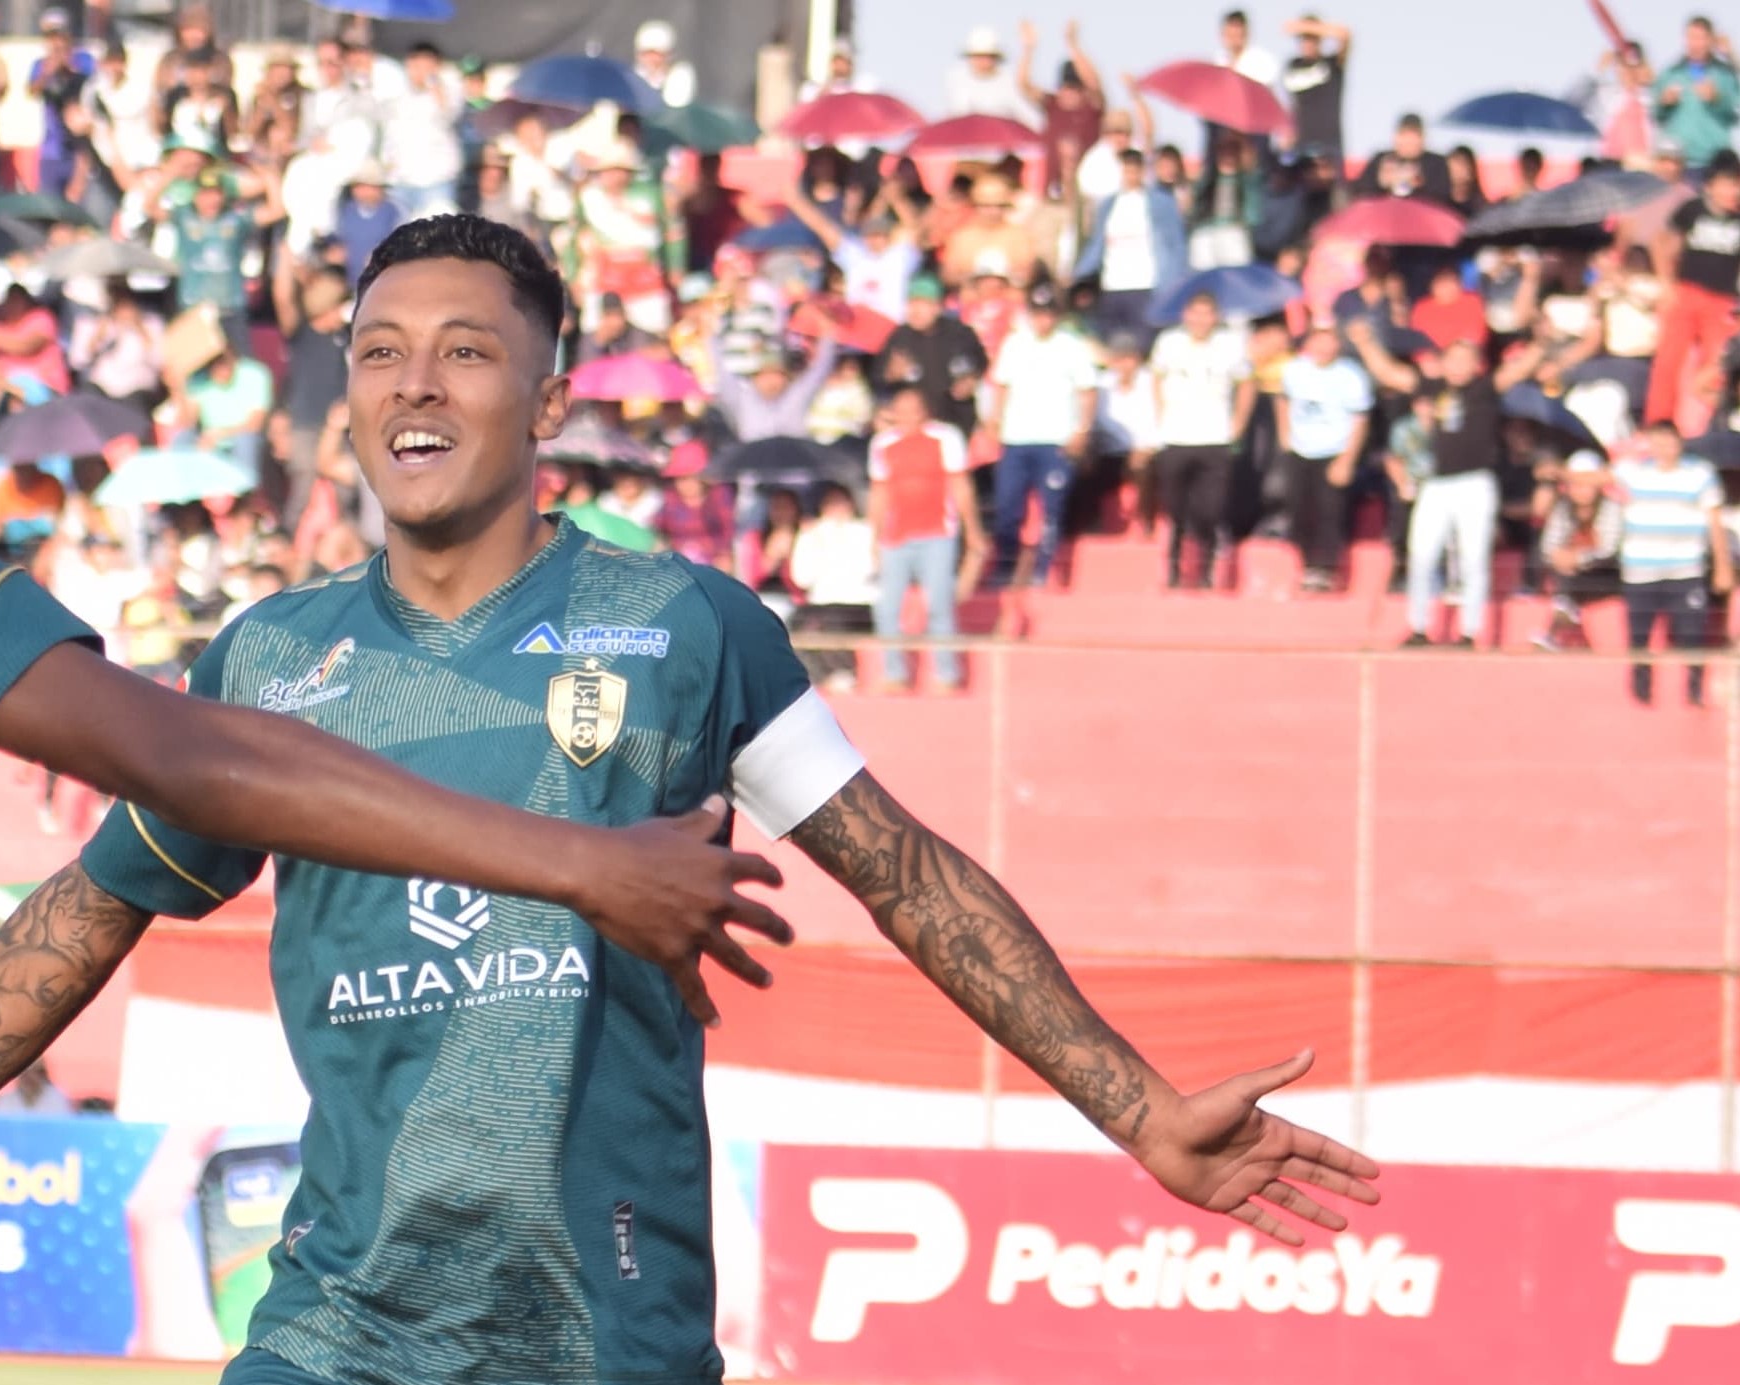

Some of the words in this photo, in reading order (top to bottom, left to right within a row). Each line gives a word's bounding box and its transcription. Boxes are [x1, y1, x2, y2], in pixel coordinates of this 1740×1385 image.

[566, 640, 669, 659] SEGUROS
[327, 960, 455, 1011] ALTA
[453, 945, 591, 992] VIDA
[329, 1001, 445, 1026] DESARROLLOS
[986, 1221, 1444, 1319] PedidosYa
